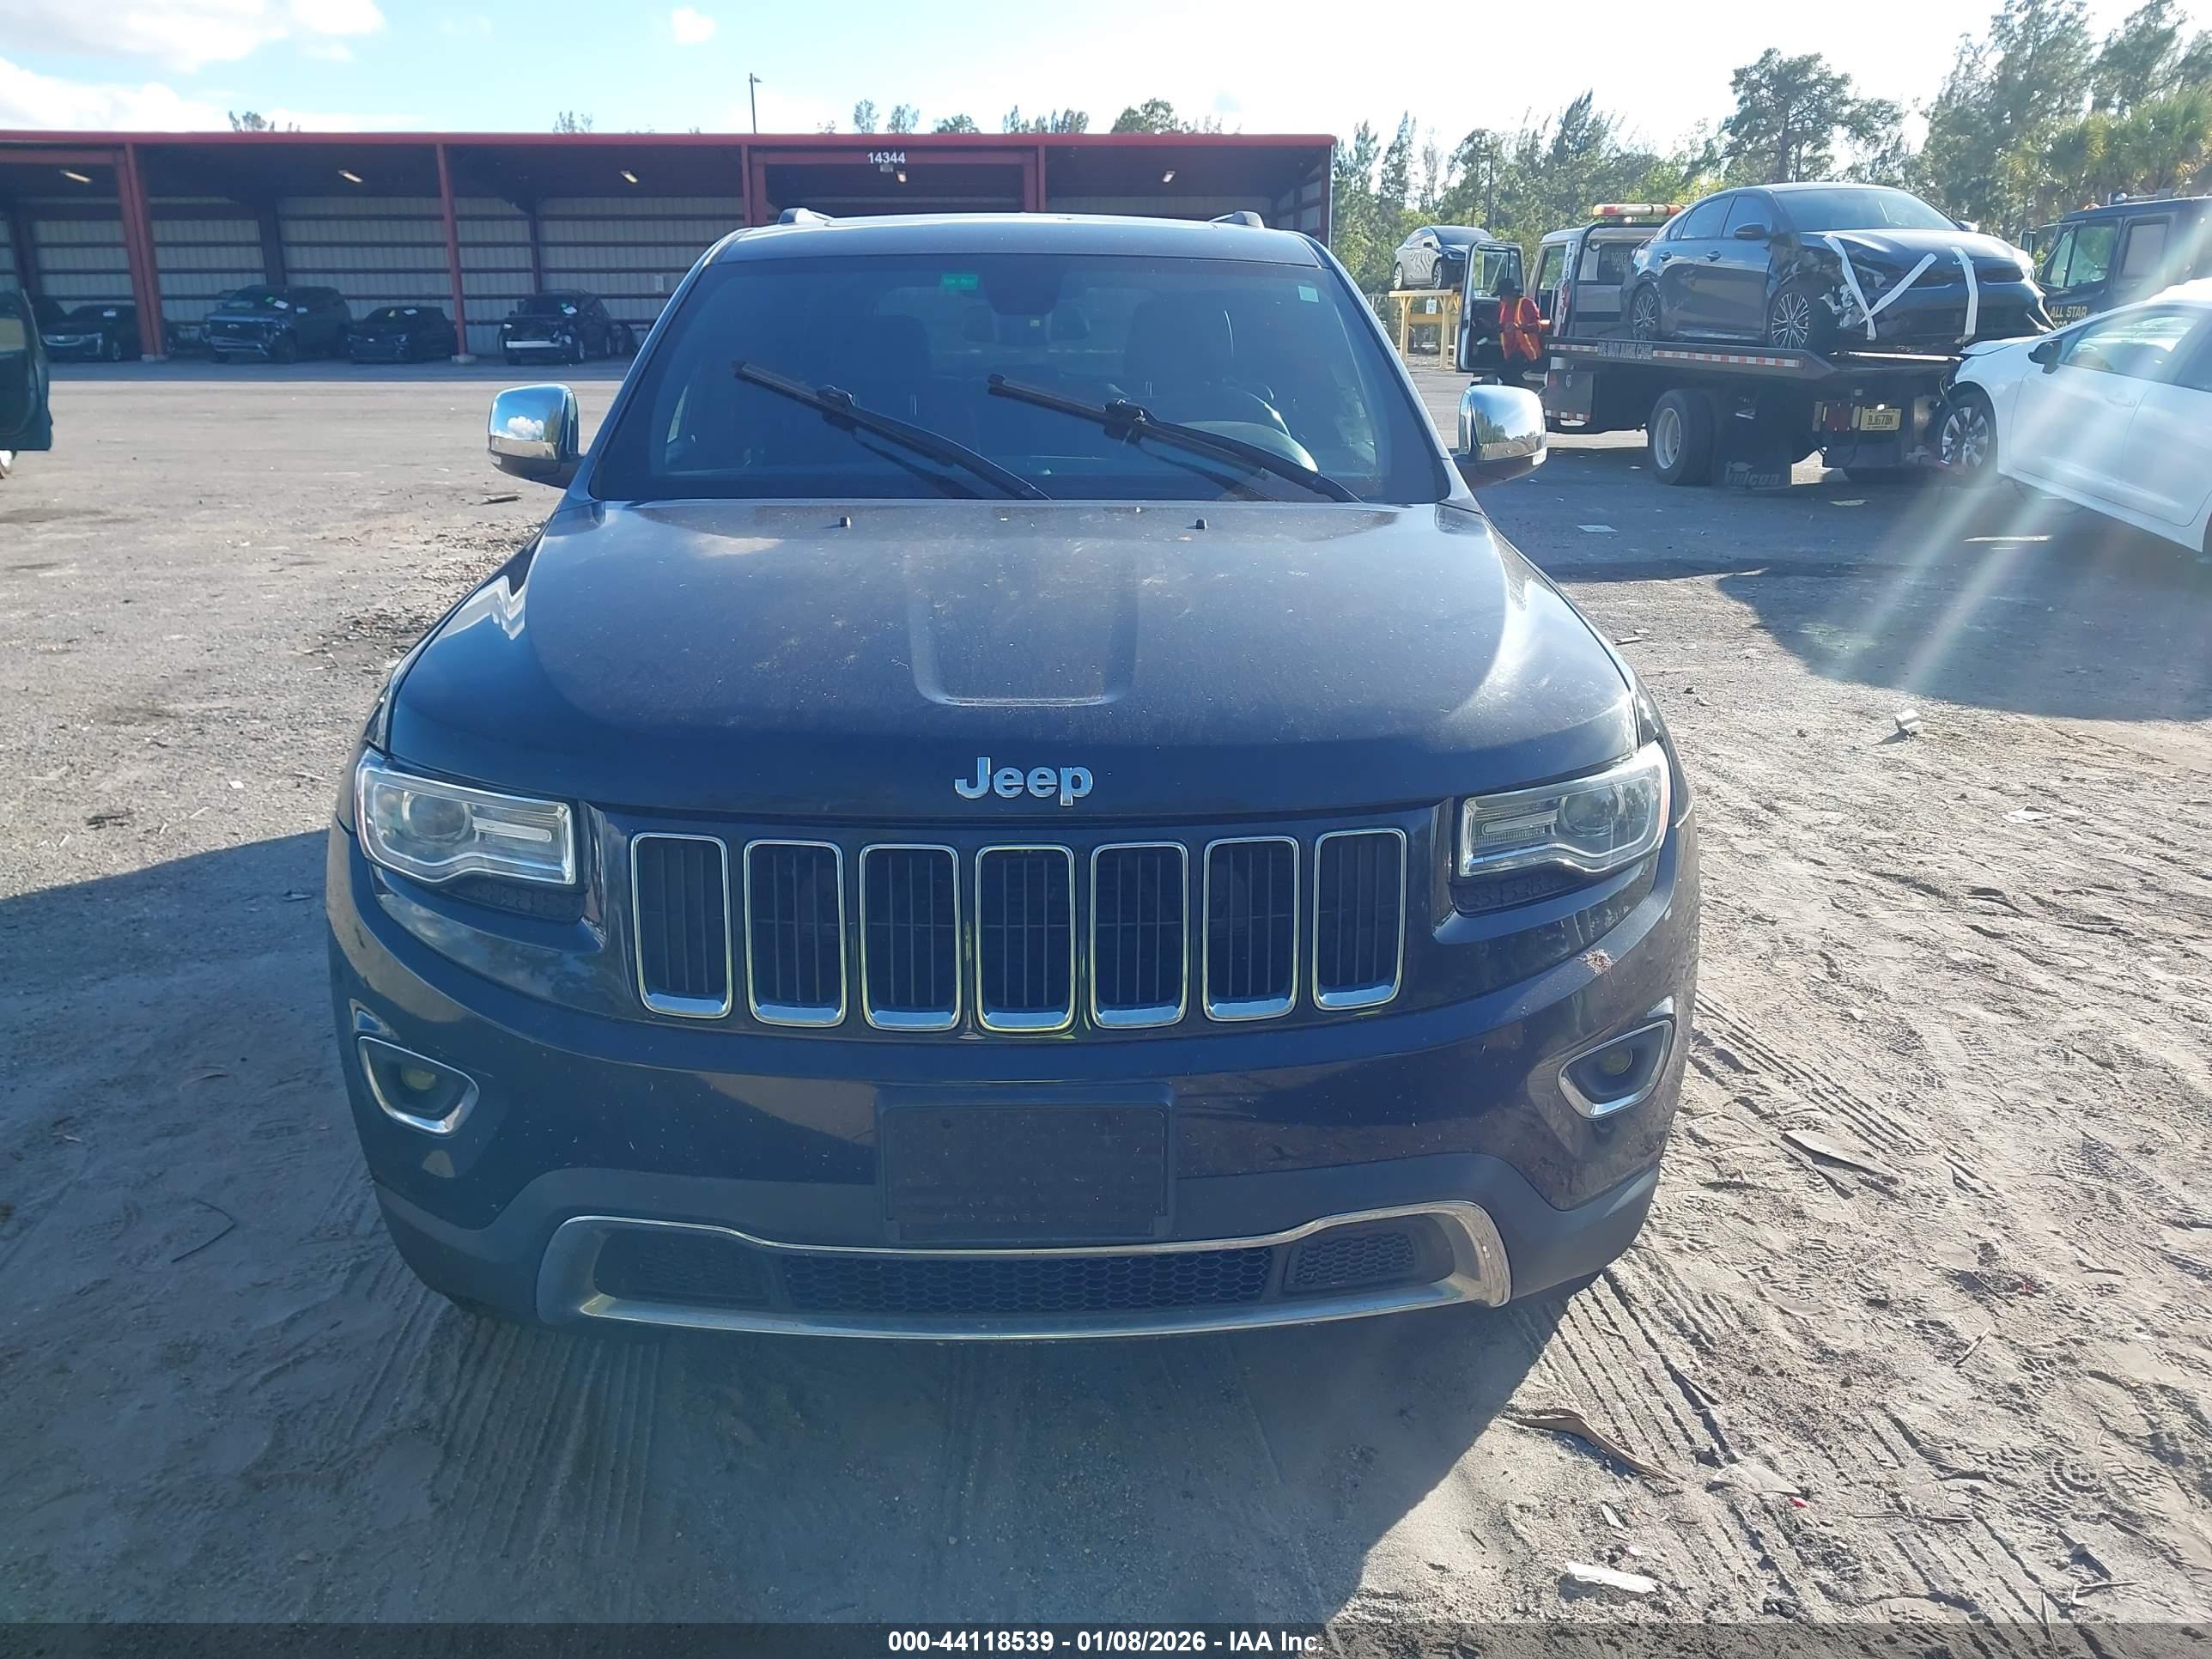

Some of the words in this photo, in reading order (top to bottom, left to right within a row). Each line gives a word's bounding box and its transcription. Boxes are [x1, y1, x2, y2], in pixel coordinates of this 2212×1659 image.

[867, 152, 906, 164] 14344
[2050, 306, 2063, 319] ALL
[2066, 306, 2088, 319] STAR
[954, 757, 1094, 807] Jeep
